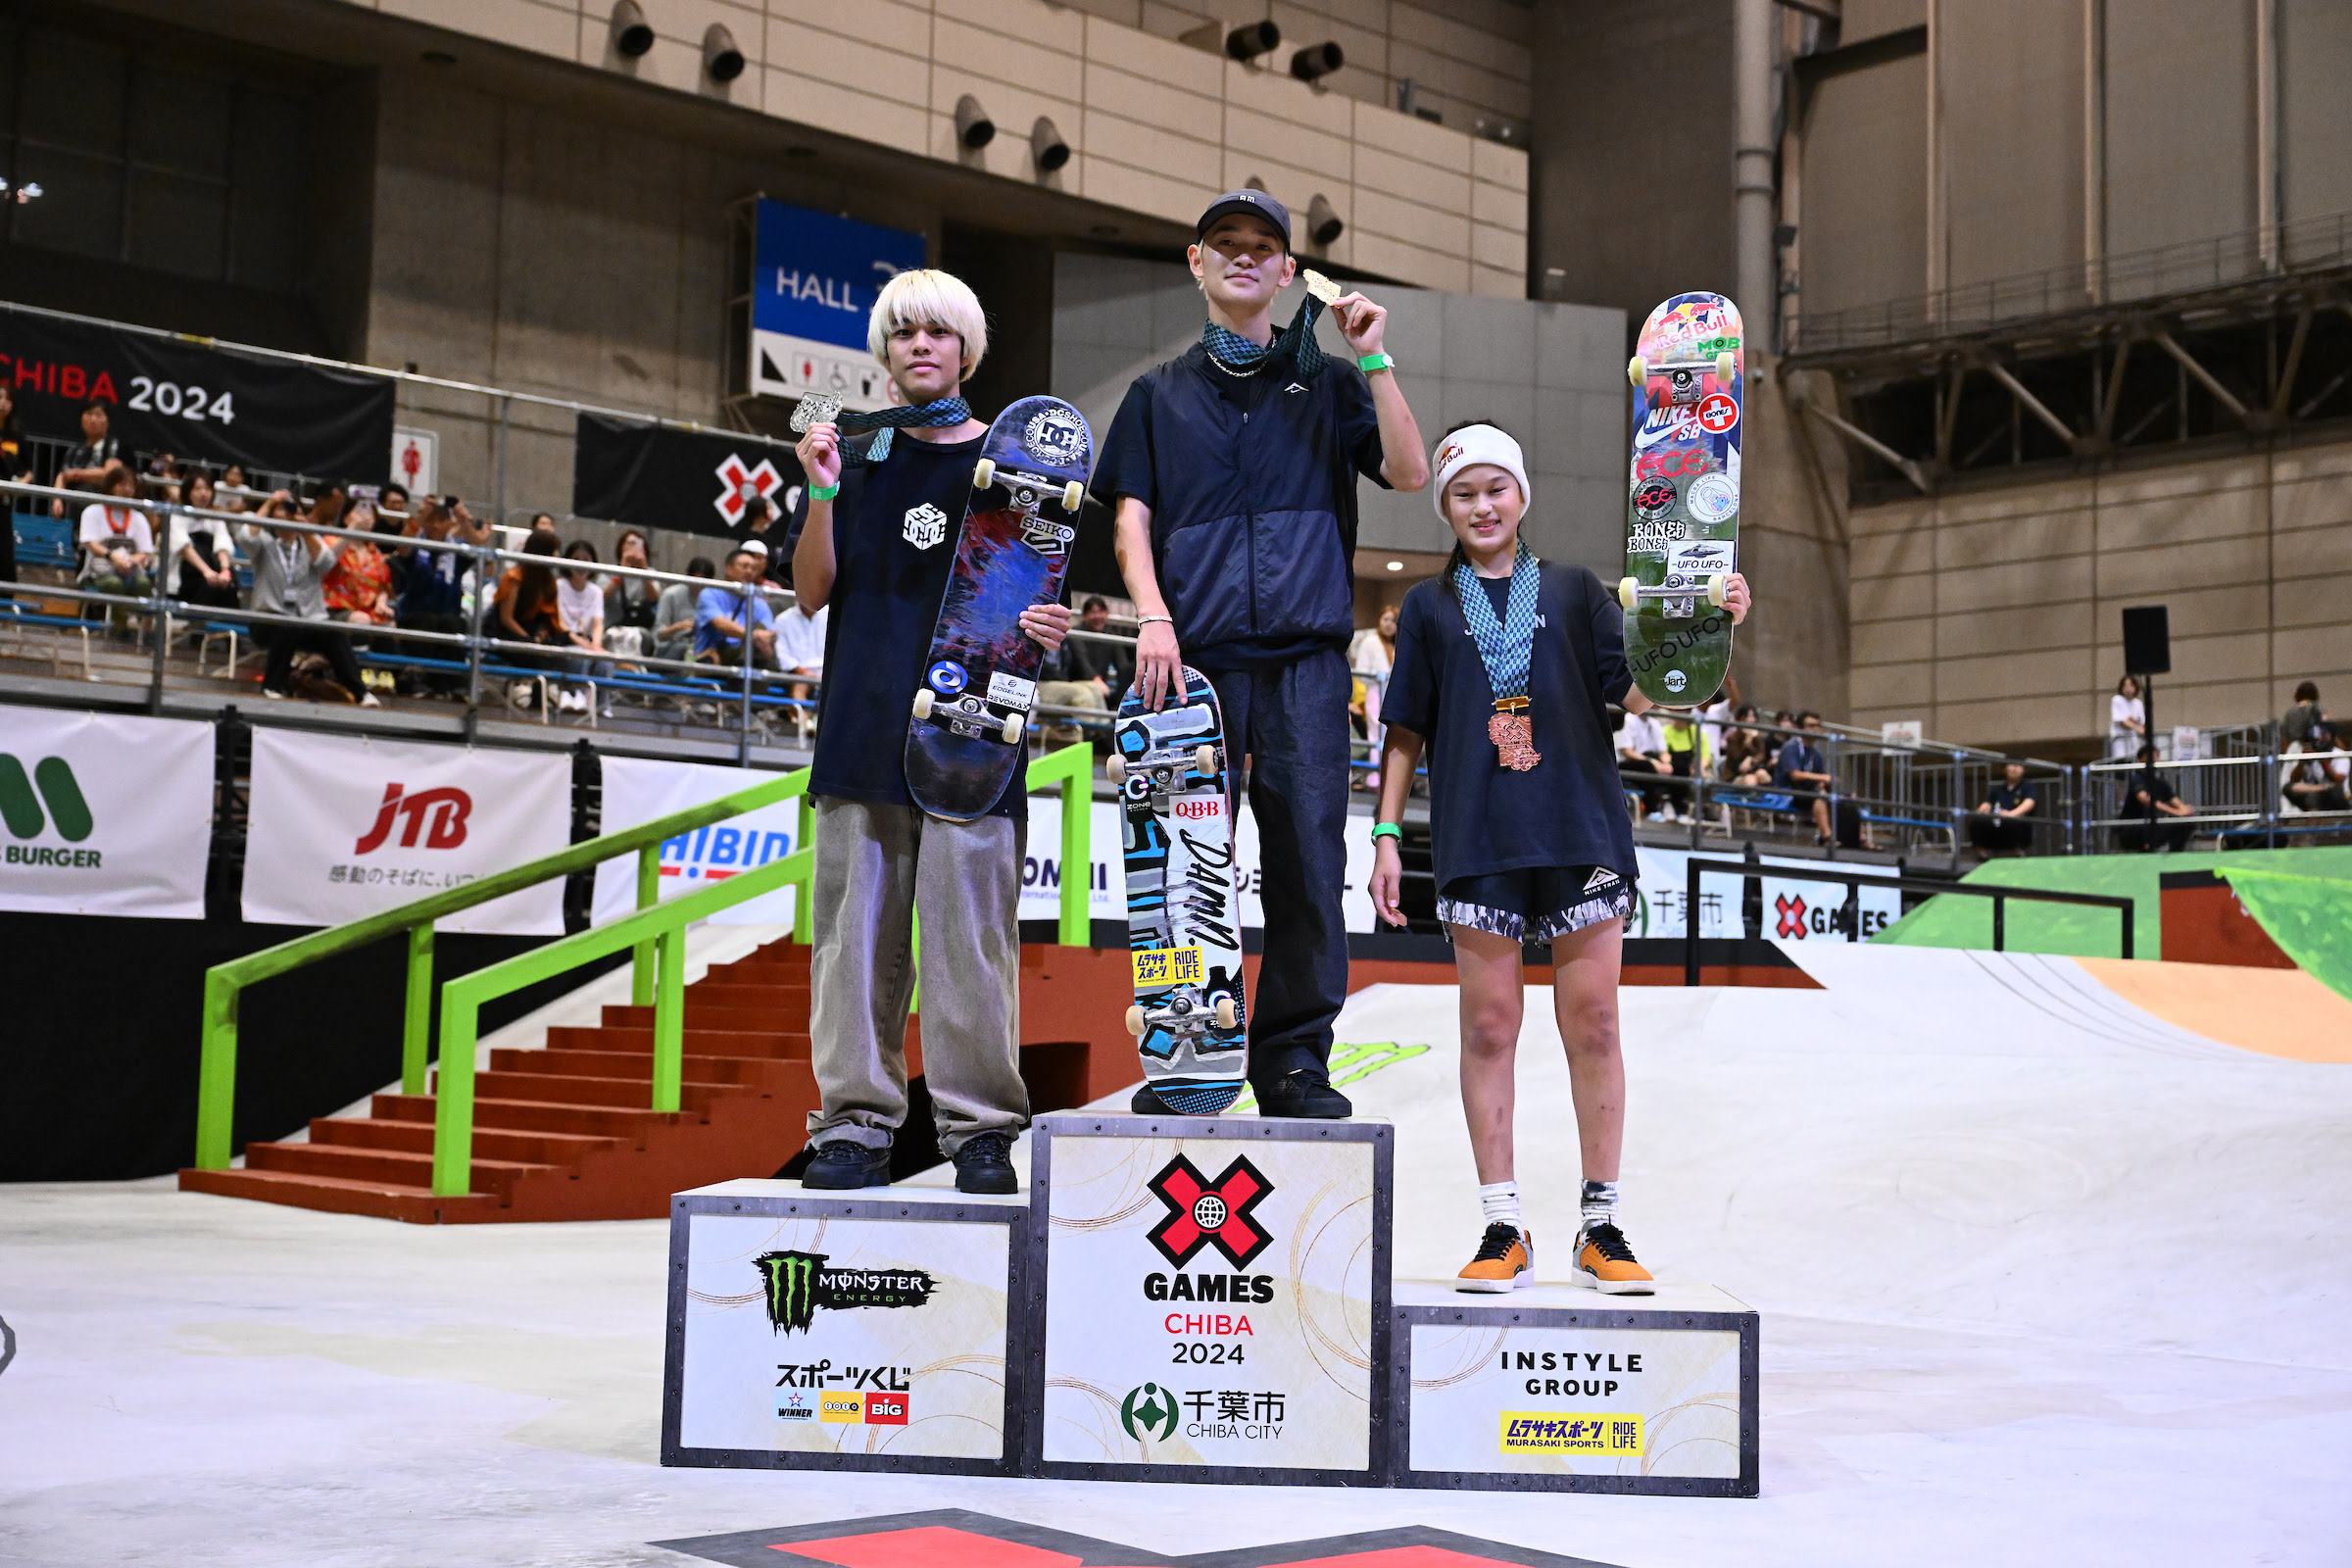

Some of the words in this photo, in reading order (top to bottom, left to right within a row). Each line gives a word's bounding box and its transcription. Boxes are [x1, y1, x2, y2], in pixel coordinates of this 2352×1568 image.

[776, 267, 858, 313] HALL
[1656, 327, 1692, 349] Red
[1694, 315, 1729, 335] Bull
[1697, 337, 1740, 353] MOB
[128, 376, 235, 424] 2024
[1644, 403, 1692, 429] NIKE
[1678, 422, 1703, 441] SB
[1446, 447, 1464, 464] Bull
[1022, 516, 1073, 540] SEIKO
[1633, 520, 1687, 539] BONES
[1628, 537, 1669, 553] BONES
[992, 685, 1028, 699] EDGELINK
[988, 694, 1029, 710] REVOMAX
[355, 782, 472, 855] JTB
[6, 845, 102, 869] BURGER
[328, 864, 487, 888] 感動のそばに、いつ
[1584, 885, 1602, 896] NIKE
[1811, 906, 1887, 937] GAES
[1137, 954, 1166, 966] ムラサキ
[1174, 950, 1199, 965] RIDE
[1139, 965, 1167, 979] スポーツ
[1176, 964, 1200, 980] LIFE
[819, 1272, 925, 1292] MONSTER
[1144, 1272, 1274, 1303] GAMES
[833, 1294, 907, 1302] ENERGY
[1164, 1313, 1253, 1336] CHIBA
[1172, 1343, 1245, 1364] 2024
[1501, 1351, 1642, 1372] INSTYLE
[775, 1358, 911, 1391] スポーツくじ
[1526, 1379, 1618, 1396] GROUP
[778, 1407, 812, 1418] WINNER
[1183, 1390, 1285, 1423] 千葉市
[1187, 1423, 1239, 1439] CHIBA
[1245, 1424, 1283, 1439] CITY
[1507, 1419, 1604, 1439] ムラサキスポーツ
[1612, 1422, 1637, 1436] RIDE
[1506, 1439, 1561, 1447] MURASAKI
[1563, 1440, 1604, 1448] SPORTS
[1612, 1436, 1637, 1448] LIFE
